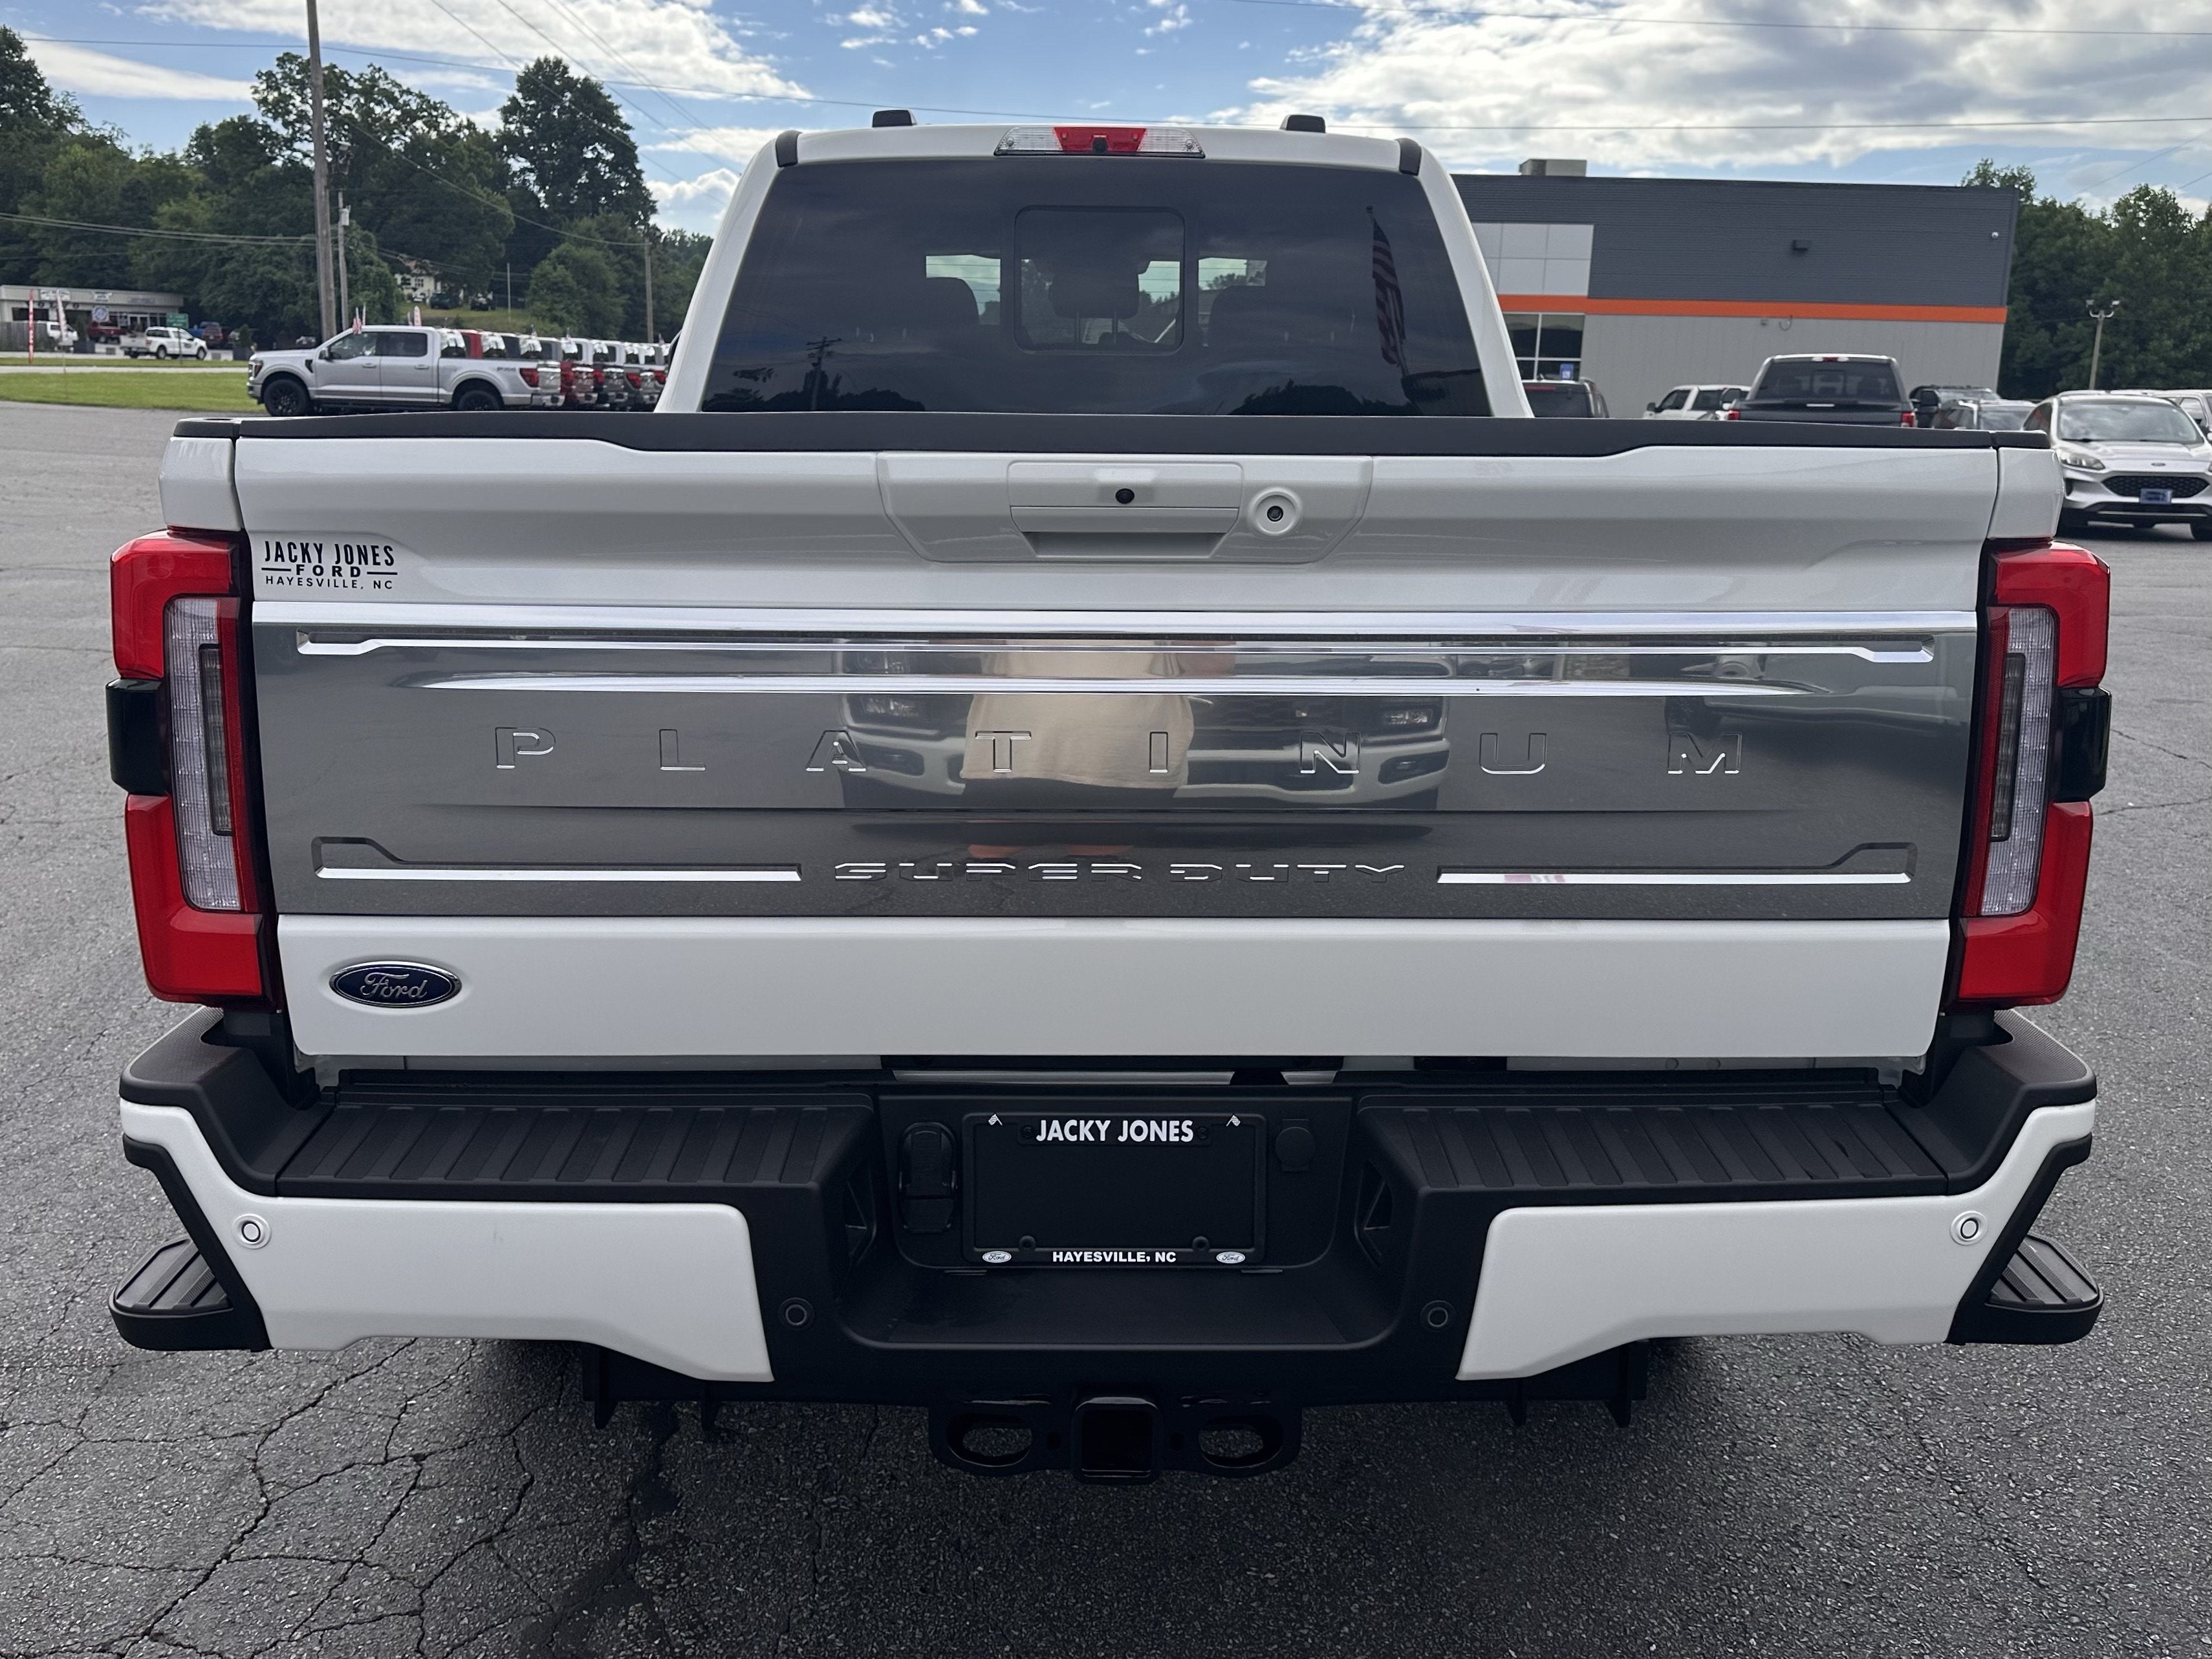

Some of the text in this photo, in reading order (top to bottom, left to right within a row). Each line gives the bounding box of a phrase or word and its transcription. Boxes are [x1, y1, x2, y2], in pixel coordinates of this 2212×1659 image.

[265, 540, 395, 567] JACKY JONES
[296, 564, 362, 578] FORD
[265, 576, 393, 590] HAYESVILLE, NC
[495, 726, 1742, 775] PLATINUM
[834, 862, 1405, 884] SUPER DUTY
[360, 971, 428, 999] Ford
[1036, 1119, 1194, 1143] JACKY JONES
[1052, 1251, 1176, 1263] HAYESVILLE, NC
